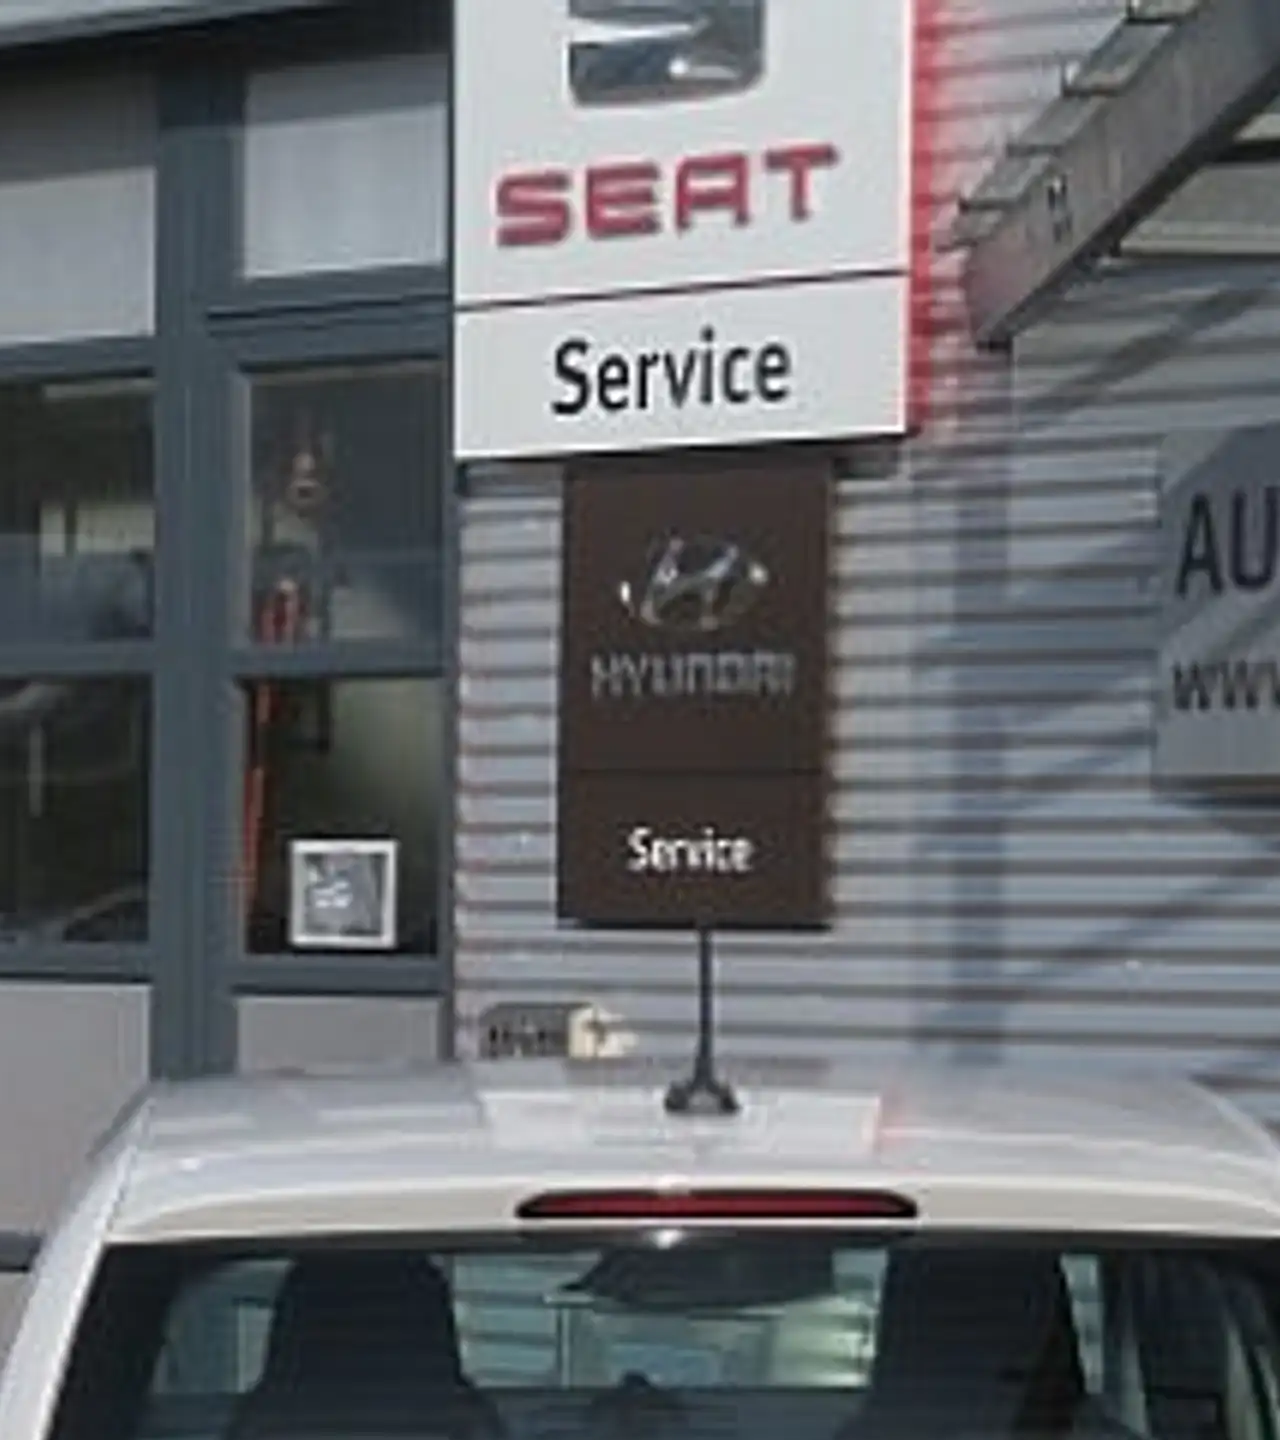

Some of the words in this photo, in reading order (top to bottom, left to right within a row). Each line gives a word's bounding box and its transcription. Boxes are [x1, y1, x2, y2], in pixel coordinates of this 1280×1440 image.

[495, 143, 838, 247] SEAT
[550, 326, 793, 416] Service
[589, 650, 797, 698] HYUNDAI
[625, 825, 754, 873] Service
